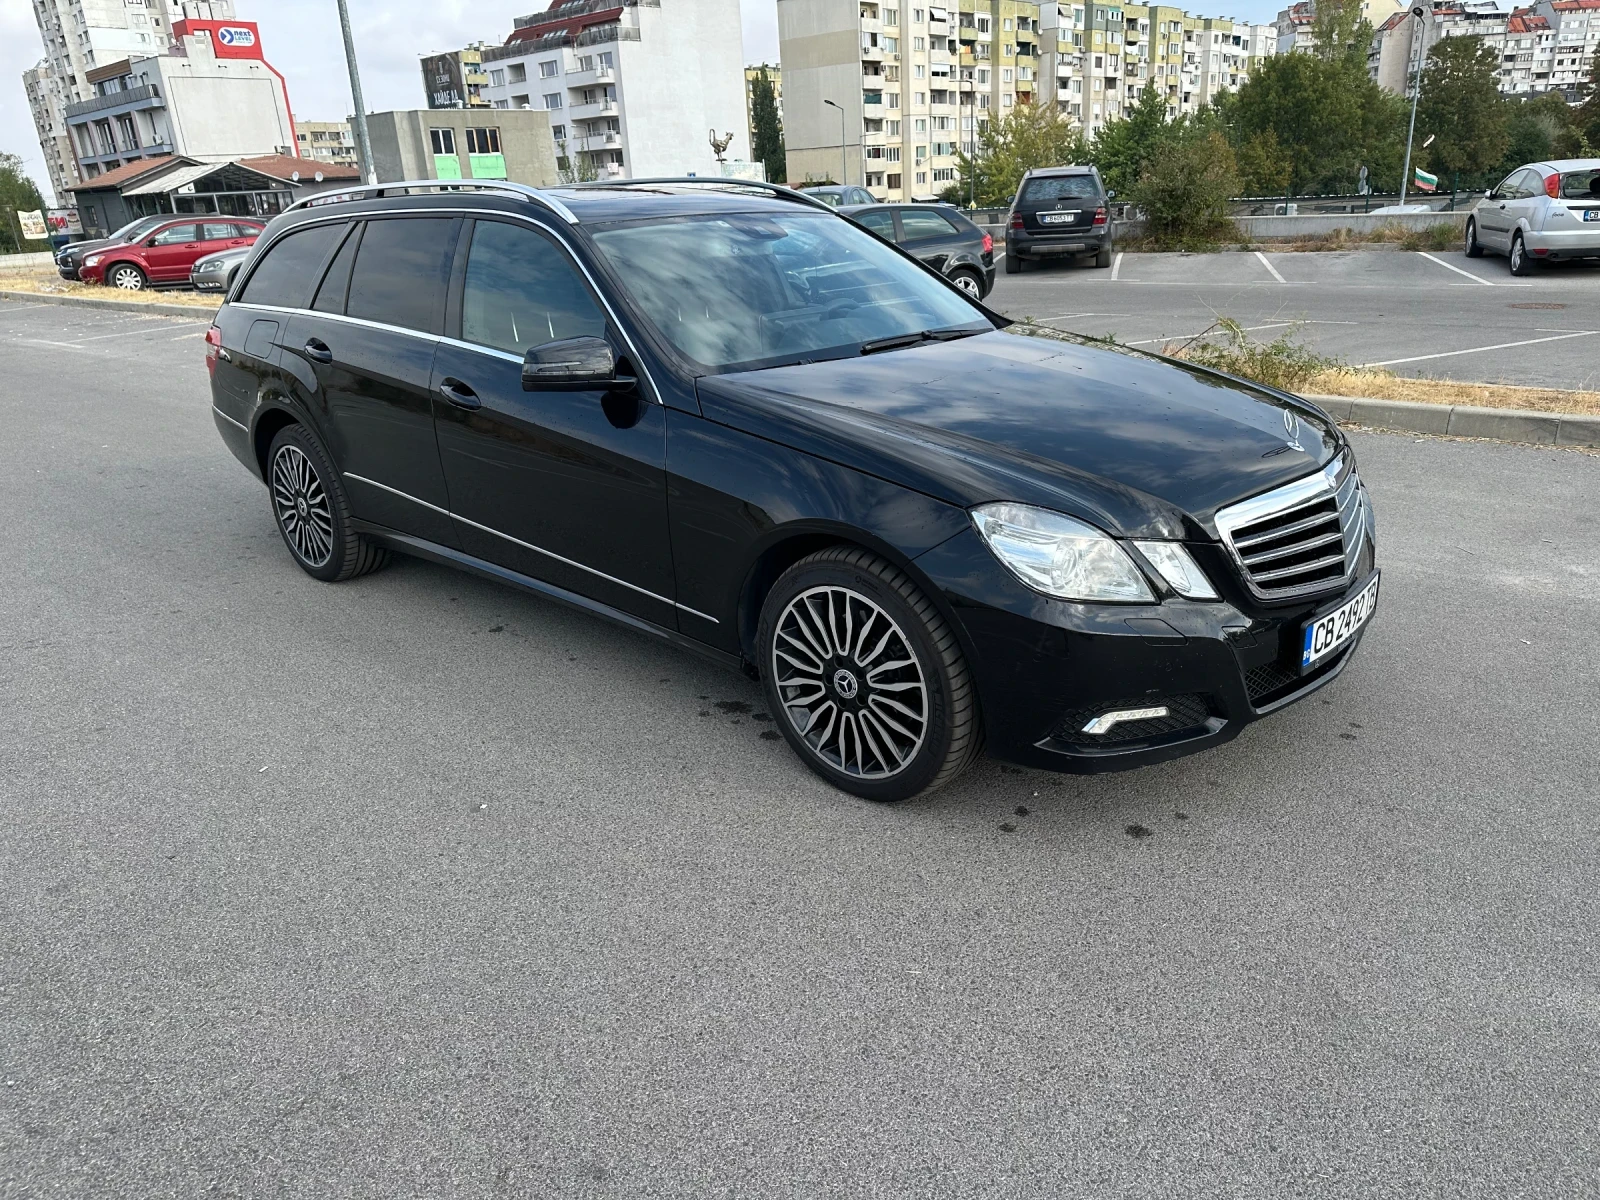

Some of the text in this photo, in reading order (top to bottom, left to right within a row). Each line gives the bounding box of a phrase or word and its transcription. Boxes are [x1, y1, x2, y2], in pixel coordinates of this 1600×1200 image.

[433, 89, 451, 106] ХАЙДЕ
[1589, 211, 1599, 219] CB
[1314, 617, 1335, 654] CB
[1336, 593, 1365, 641] 2492
